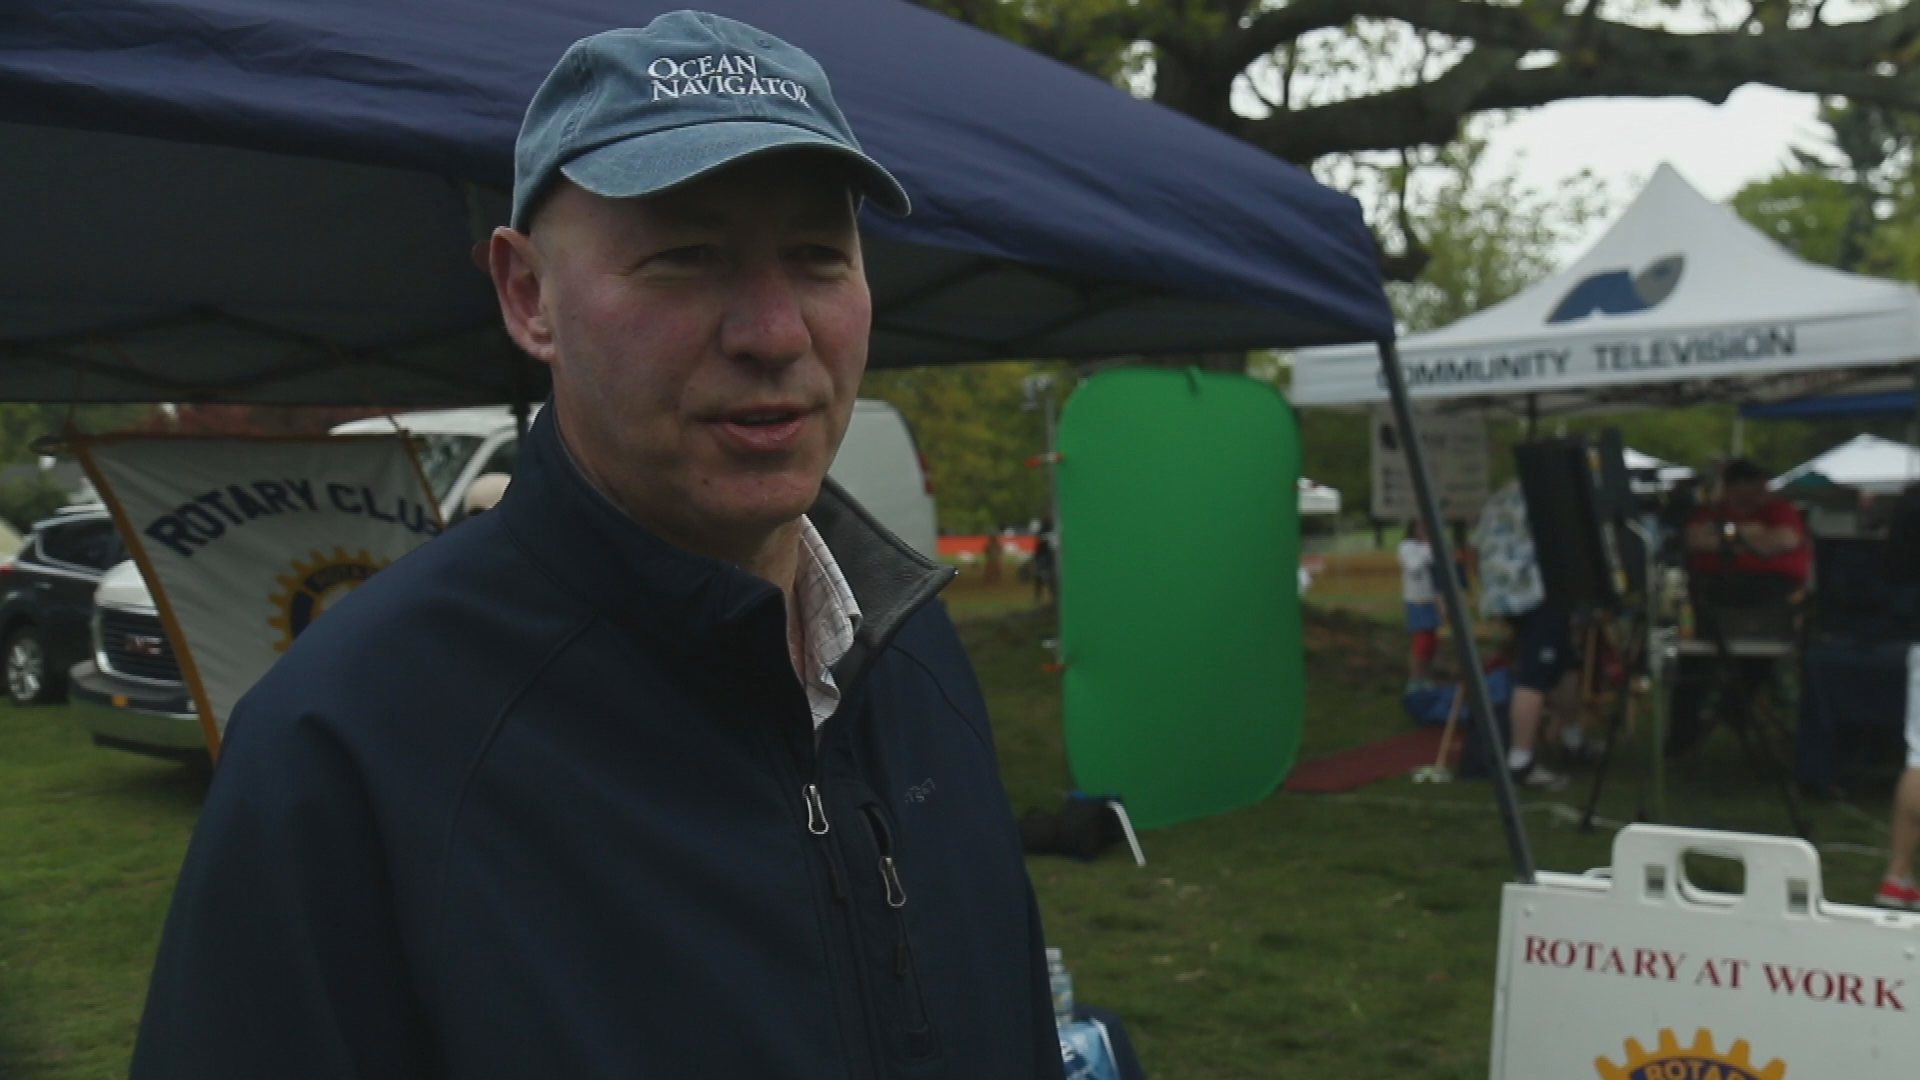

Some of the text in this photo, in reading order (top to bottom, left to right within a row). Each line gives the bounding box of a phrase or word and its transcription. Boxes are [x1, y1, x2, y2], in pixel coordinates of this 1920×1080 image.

[648, 54, 757, 79] OCEAN
[651, 76, 813, 109] NAVIGATOR
[1592, 324, 1799, 371] TELEVISION
[145, 479, 319, 558] ROTARY
[1523, 935, 1906, 1011] ROTARY AT WORK
